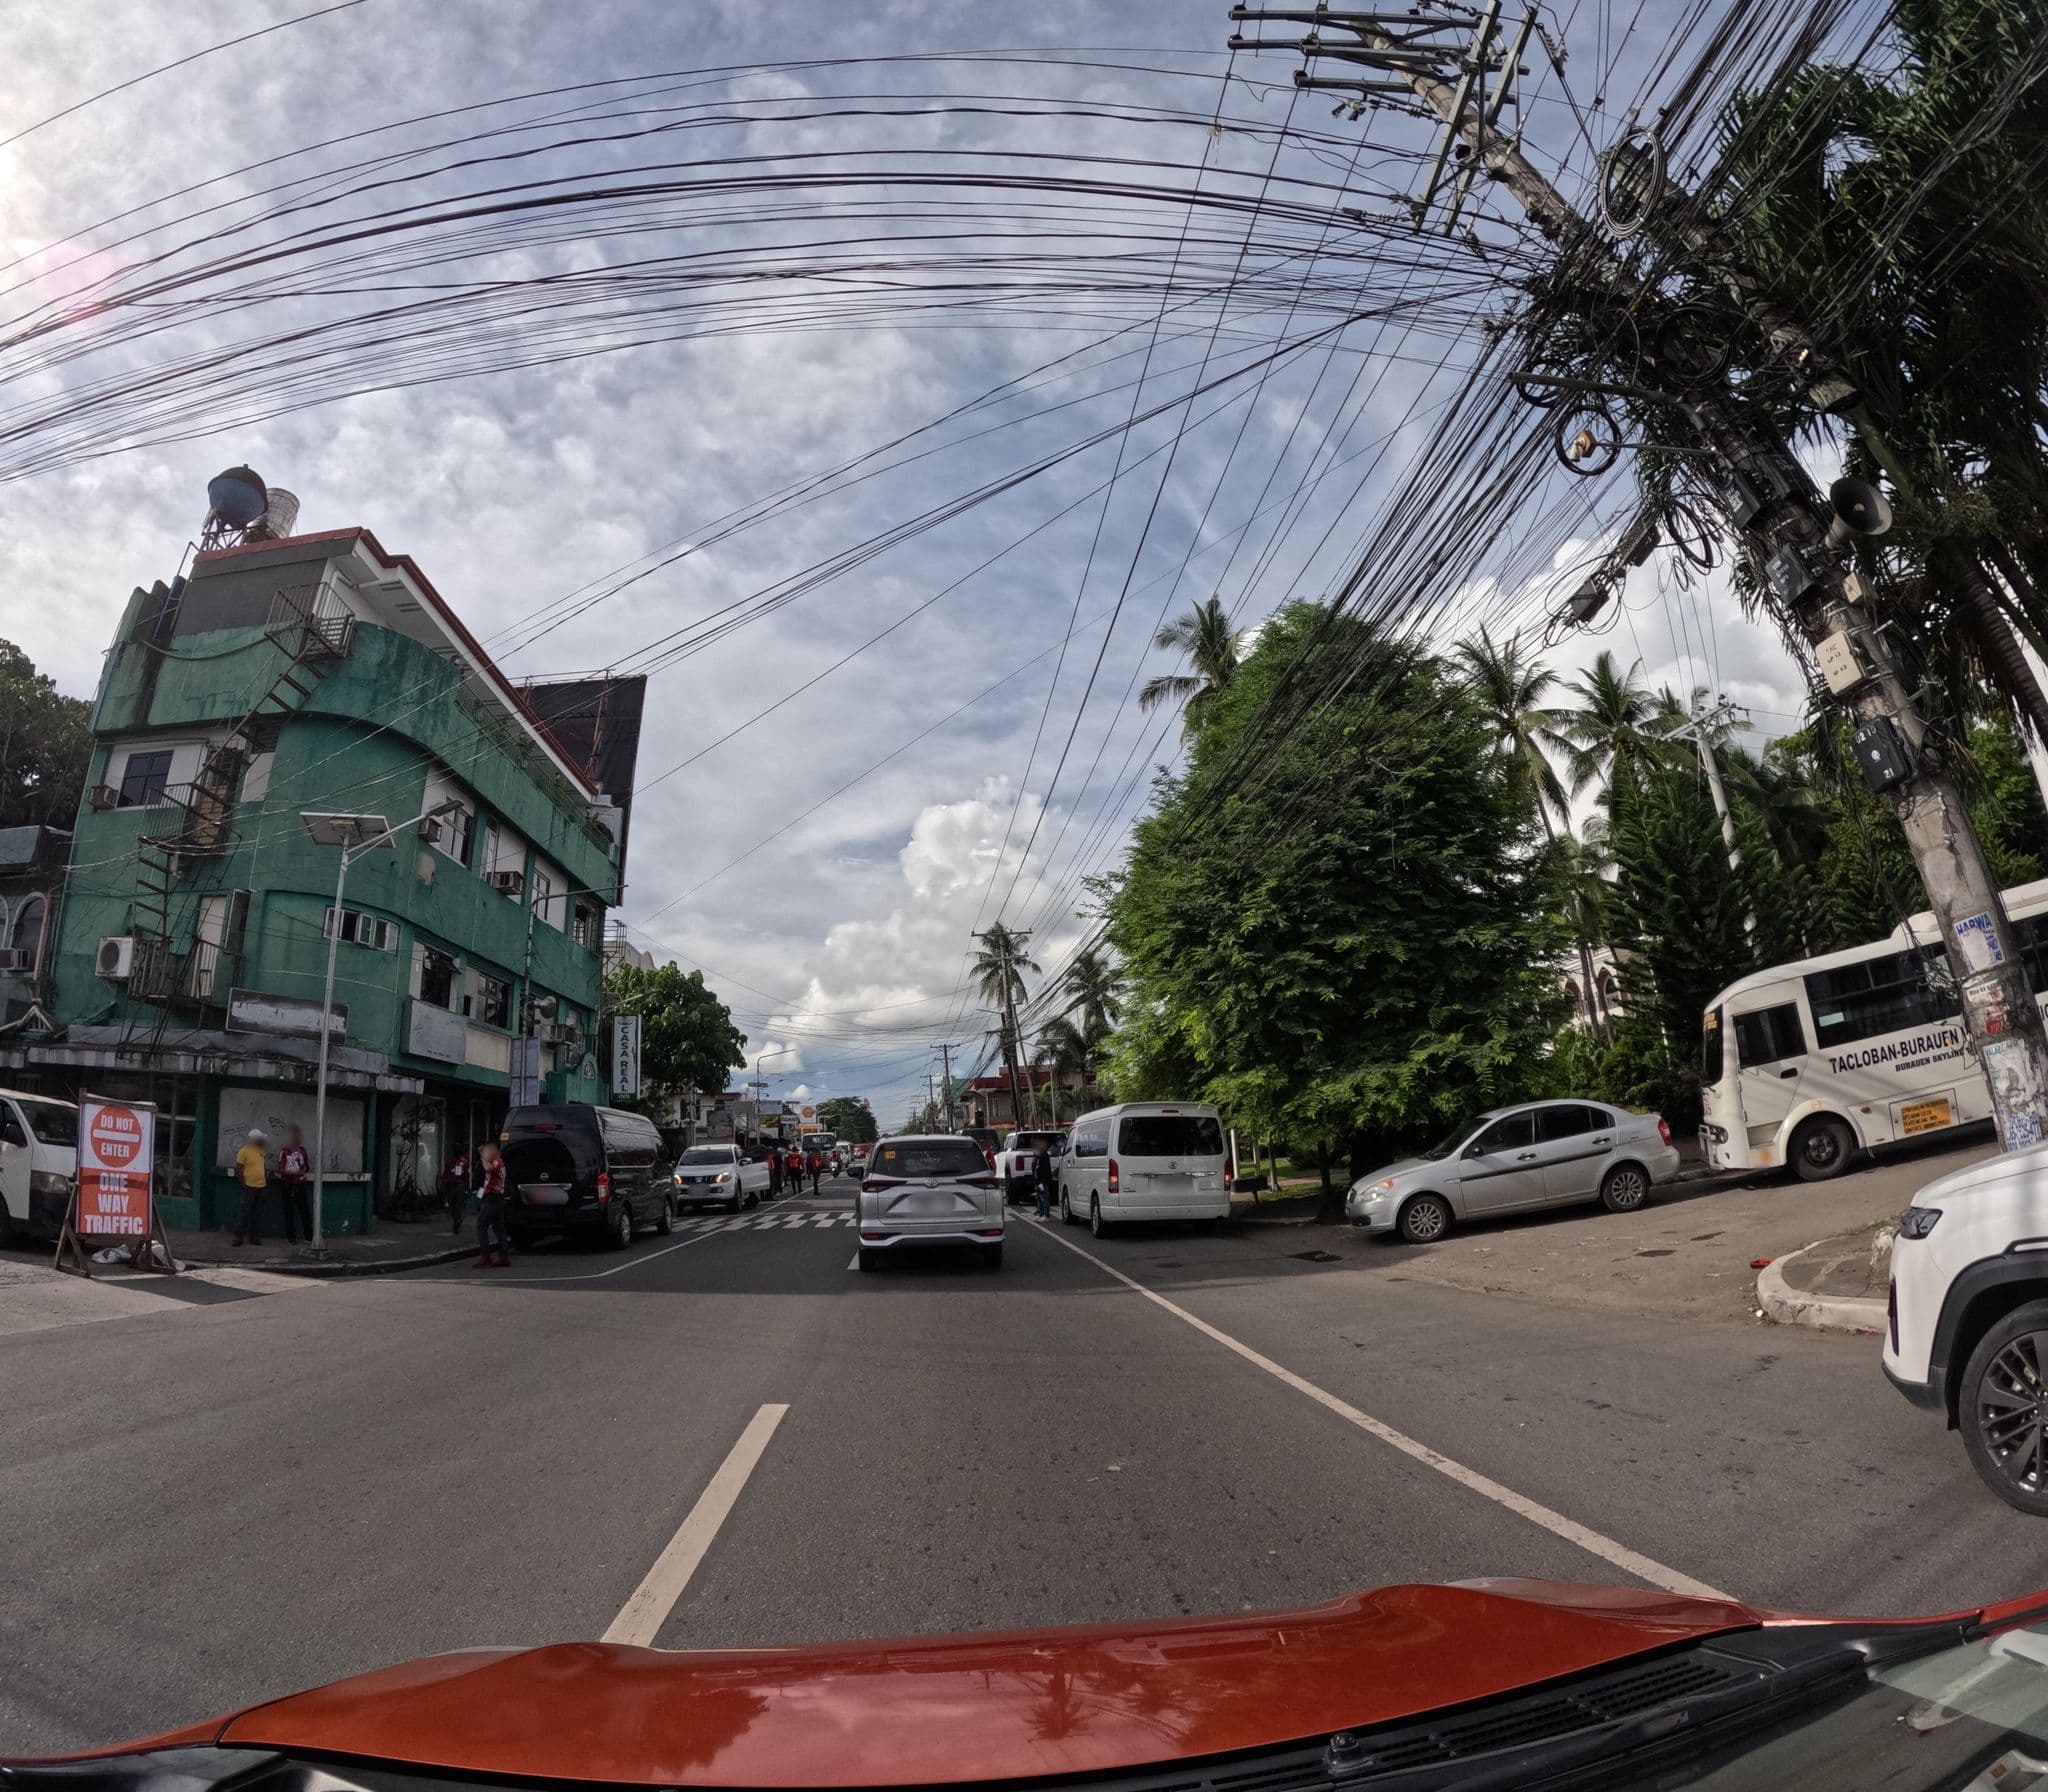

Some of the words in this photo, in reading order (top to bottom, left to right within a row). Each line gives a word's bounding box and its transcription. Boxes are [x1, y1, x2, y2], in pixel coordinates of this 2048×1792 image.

[1883, 767, 1894, 778] 21
[620, 1026, 629, 1057] CASA
[1829, 1028, 1959, 1074] TACLOBAN-BURAUEN
[1895, 1057, 1931, 1072] BURAUEN
[620, 1060, 629, 1092] REAL
[101, 1114, 113, 1128] DO
[116, 1116, 134, 1131] NOT
[101, 1143, 129, 1158] ENTER
[99, 1172, 129, 1193] ONE
[97, 1193, 130, 1214] WAY
[85, 1214, 143, 1235] TRAFFIC
